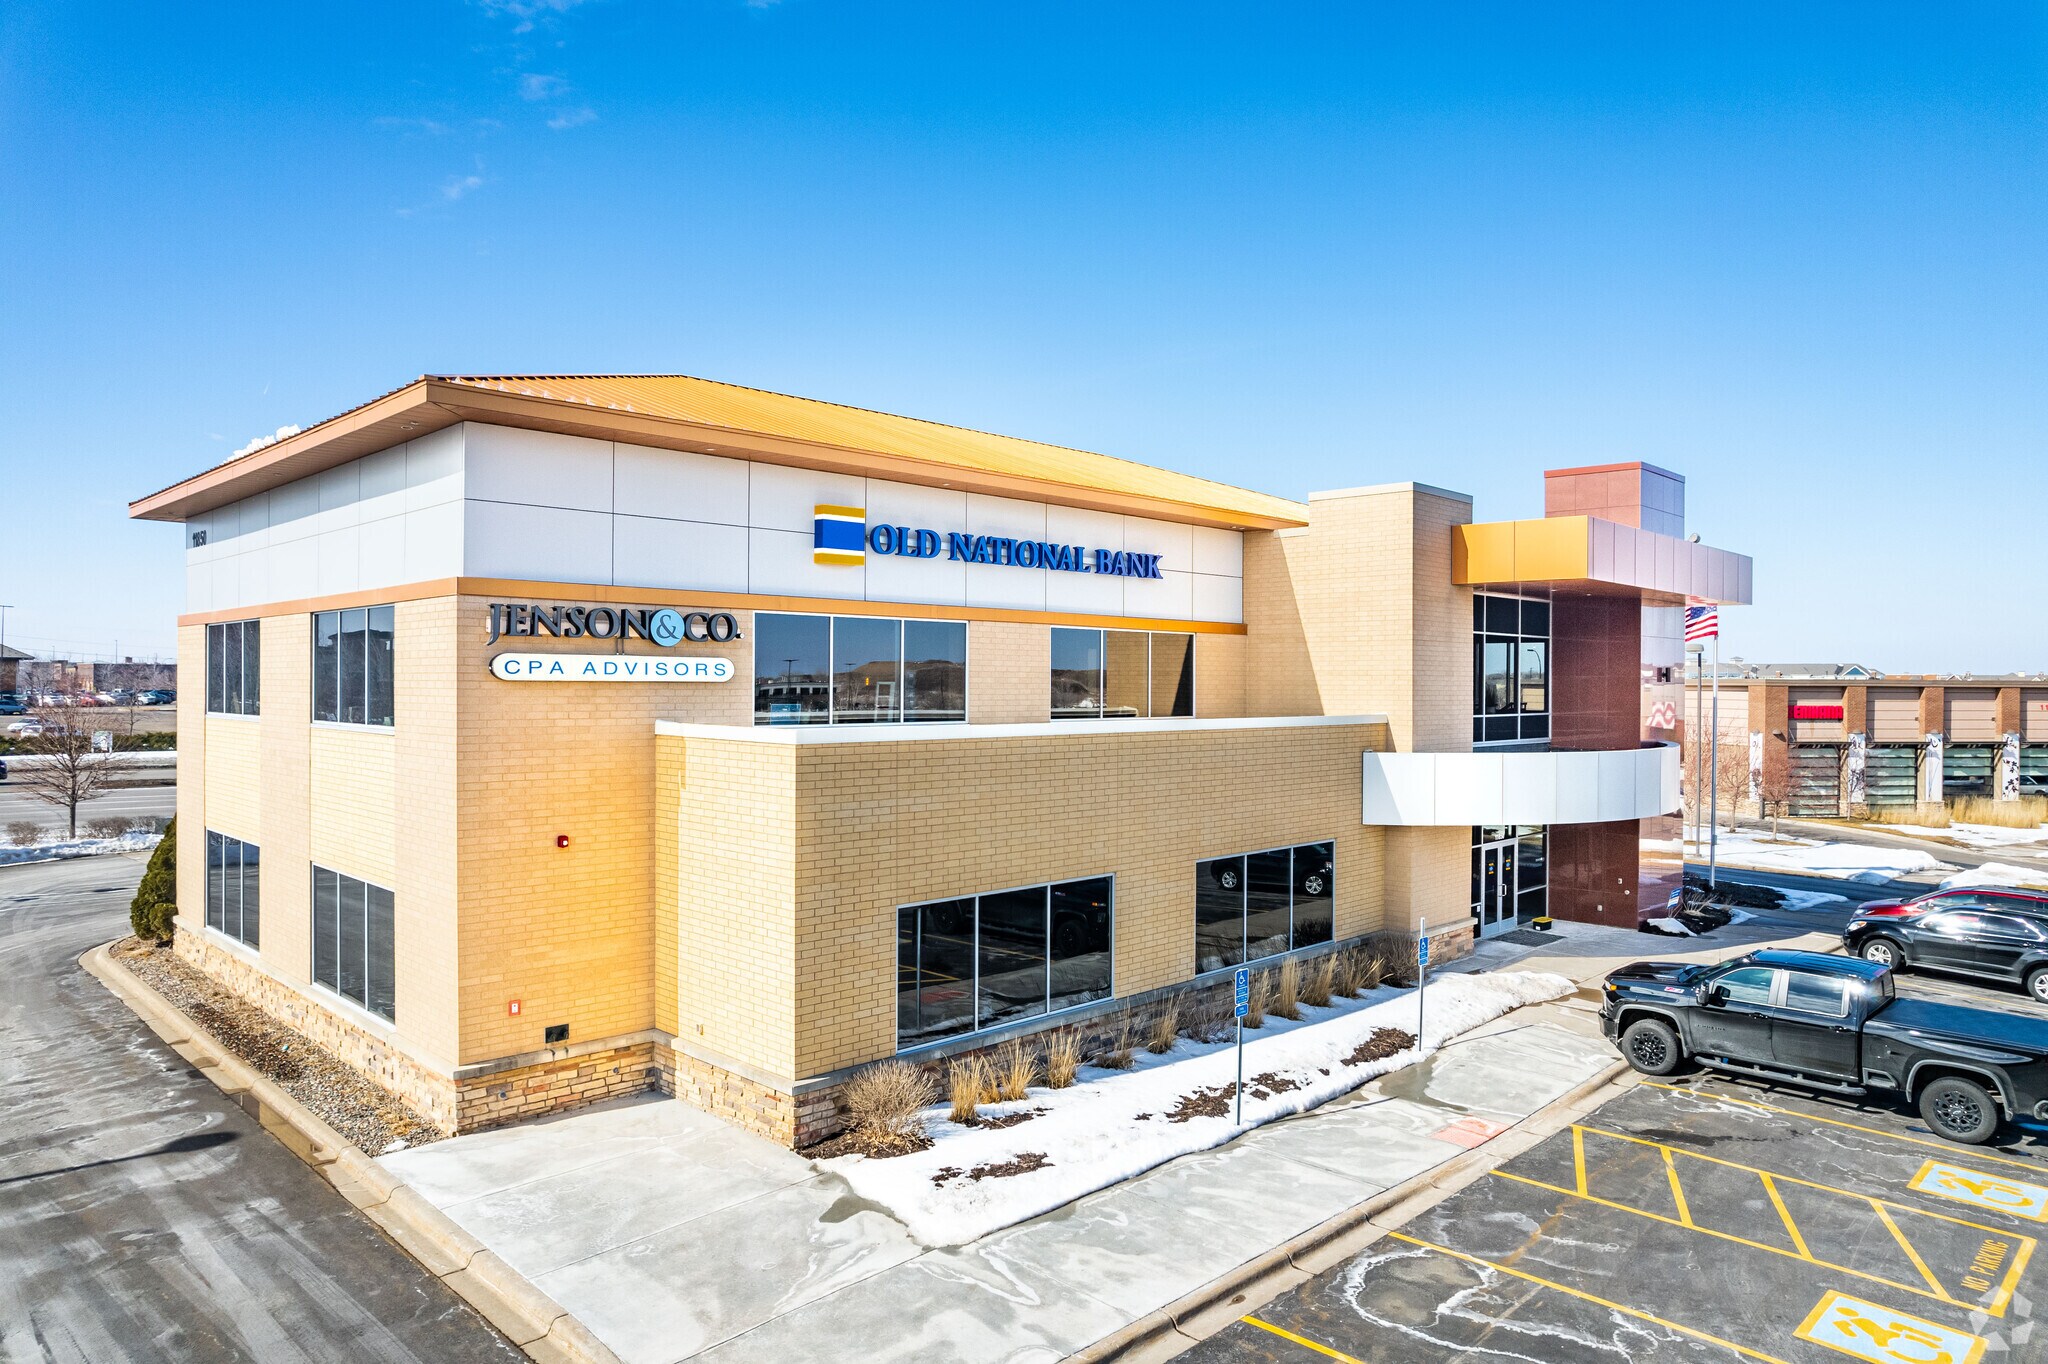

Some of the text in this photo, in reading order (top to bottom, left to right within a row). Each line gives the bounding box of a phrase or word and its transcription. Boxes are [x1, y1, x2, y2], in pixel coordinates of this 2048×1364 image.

[869, 524, 1164, 580] OLD NATIONAL BANK
[504, 659, 727, 676] CPA ADVISORS
[1961, 1239, 2009, 1292] NO PARKING
